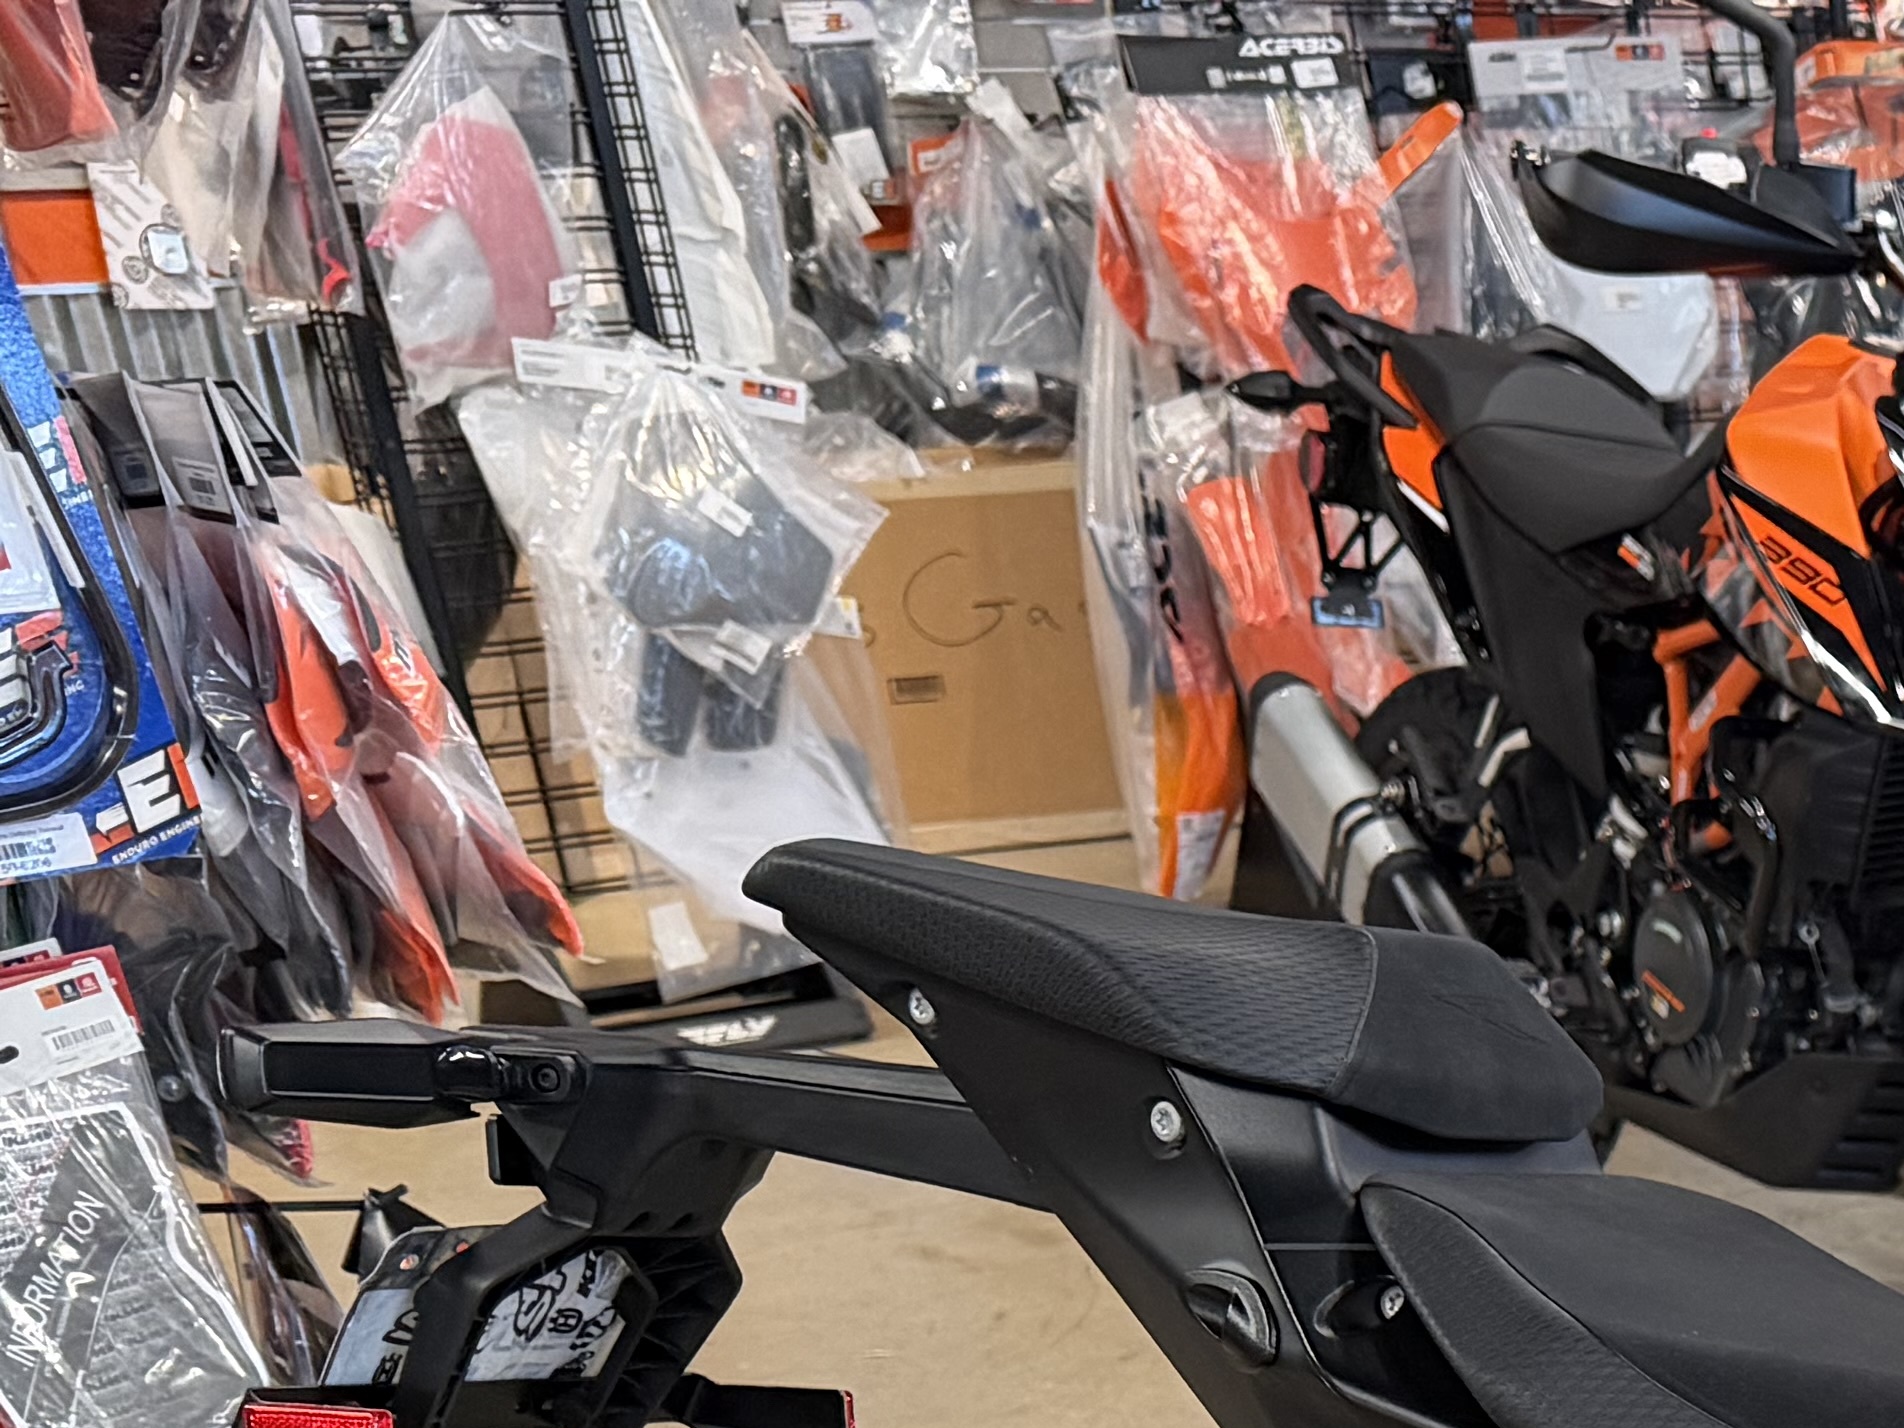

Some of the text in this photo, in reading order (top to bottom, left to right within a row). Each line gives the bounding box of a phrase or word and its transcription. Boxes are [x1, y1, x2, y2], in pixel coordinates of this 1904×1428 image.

[1760, 535, 1846, 606] 390
[111, 834, 159, 865] ENDURO
[5, 1190, 105, 1367] INFORMATION
